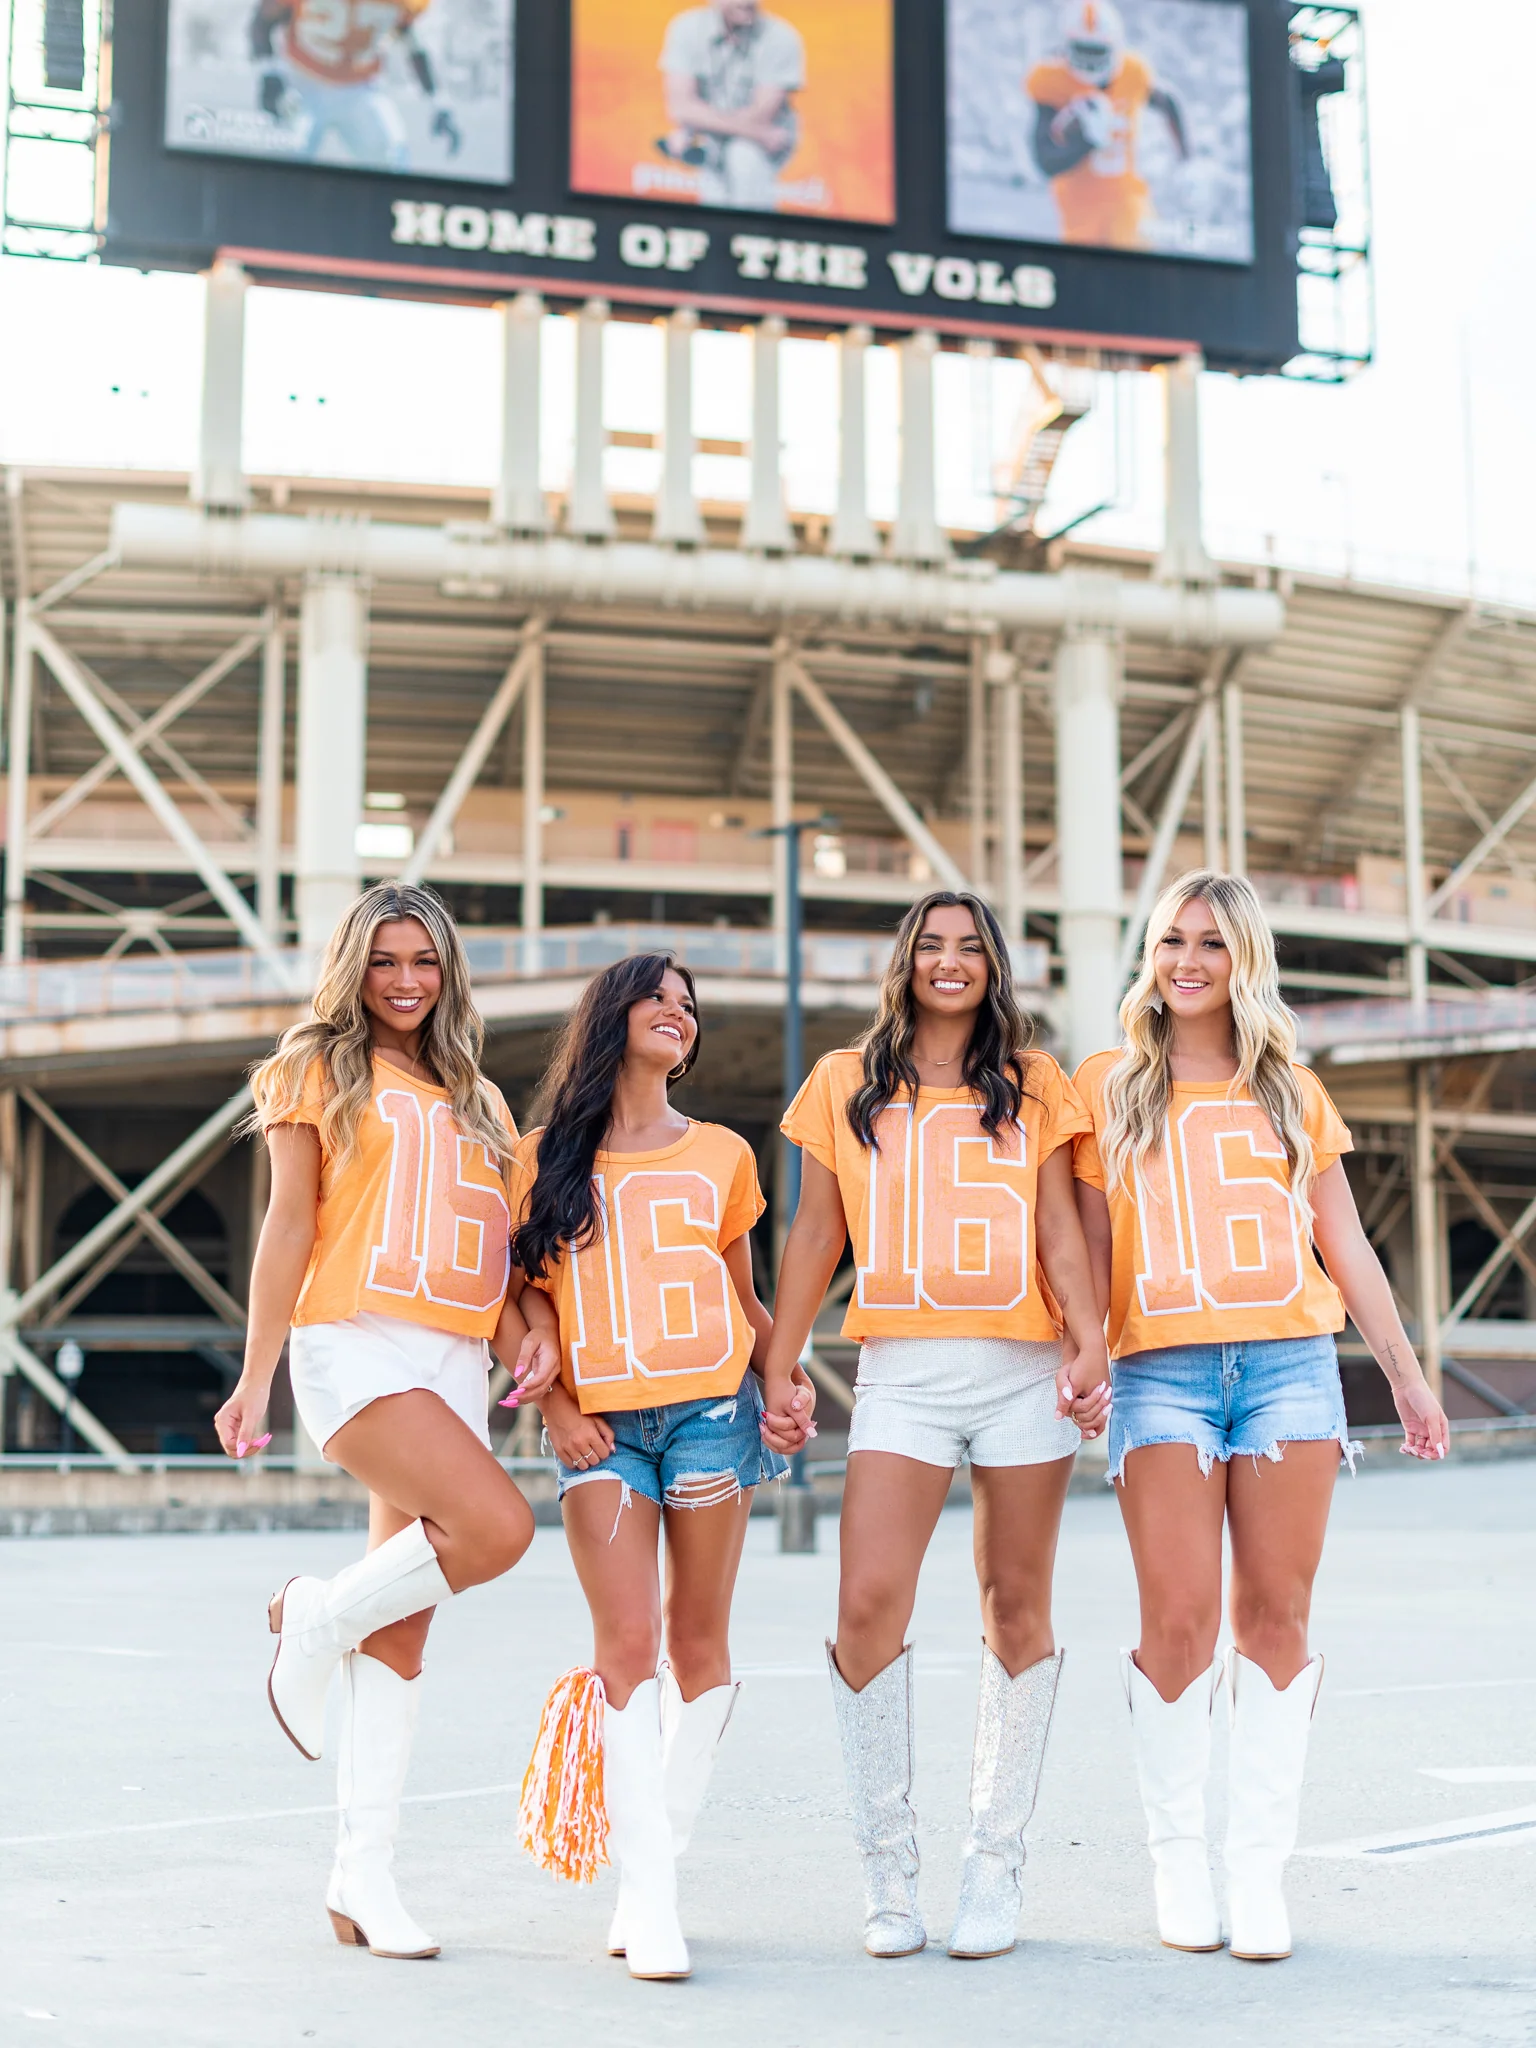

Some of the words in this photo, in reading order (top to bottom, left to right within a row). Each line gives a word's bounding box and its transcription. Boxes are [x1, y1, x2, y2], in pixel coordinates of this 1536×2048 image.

[391, 199, 596, 262] HOME
[620, 223, 709, 271] OF
[730, 234, 867, 290] THE
[887, 251, 1056, 309] VOLS
[365, 1088, 511, 1312] 16
[568, 1170, 734, 1386] 16
[857, 1102, 1028, 1310] 16
[1133, 1100, 1304, 1317] 16
